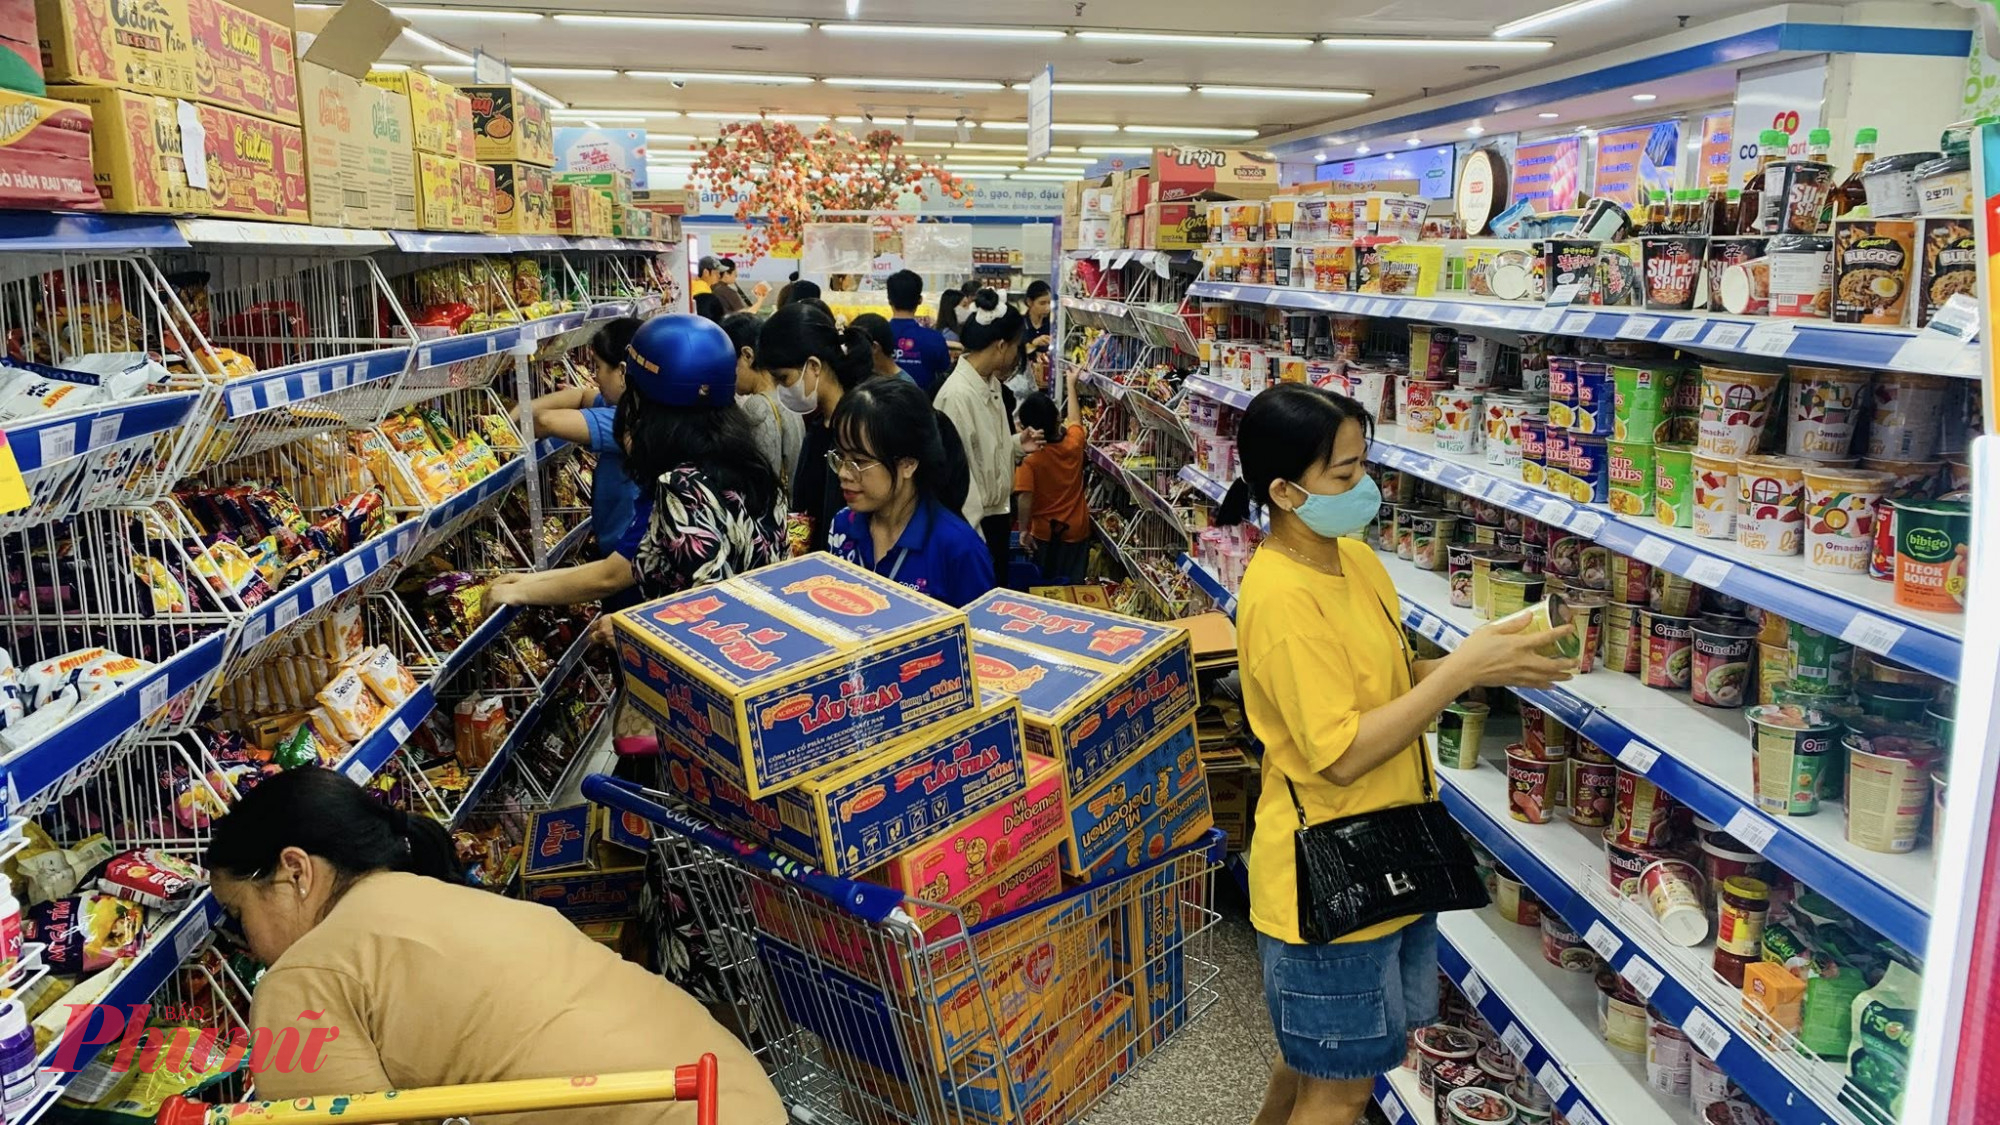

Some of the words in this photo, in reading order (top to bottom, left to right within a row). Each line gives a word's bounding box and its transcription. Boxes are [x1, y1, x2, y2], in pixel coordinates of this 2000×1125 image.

[1843, 249, 1903, 267] BULGOGI
[1647, 257, 1701, 278] SUPER
[1653, 276, 1694, 291] SPICY
[1909, 534, 1948, 551] bibigo
[1904, 562, 1944, 577] TTEOK
[1903, 573, 1943, 588] BOKKI
[1696, 638, 1741, 656] Omachi
[1003, 788, 1062, 835] Doraemon
[1081, 784, 1152, 849] Doraemon
[998, 850, 1057, 899] Doraemon
